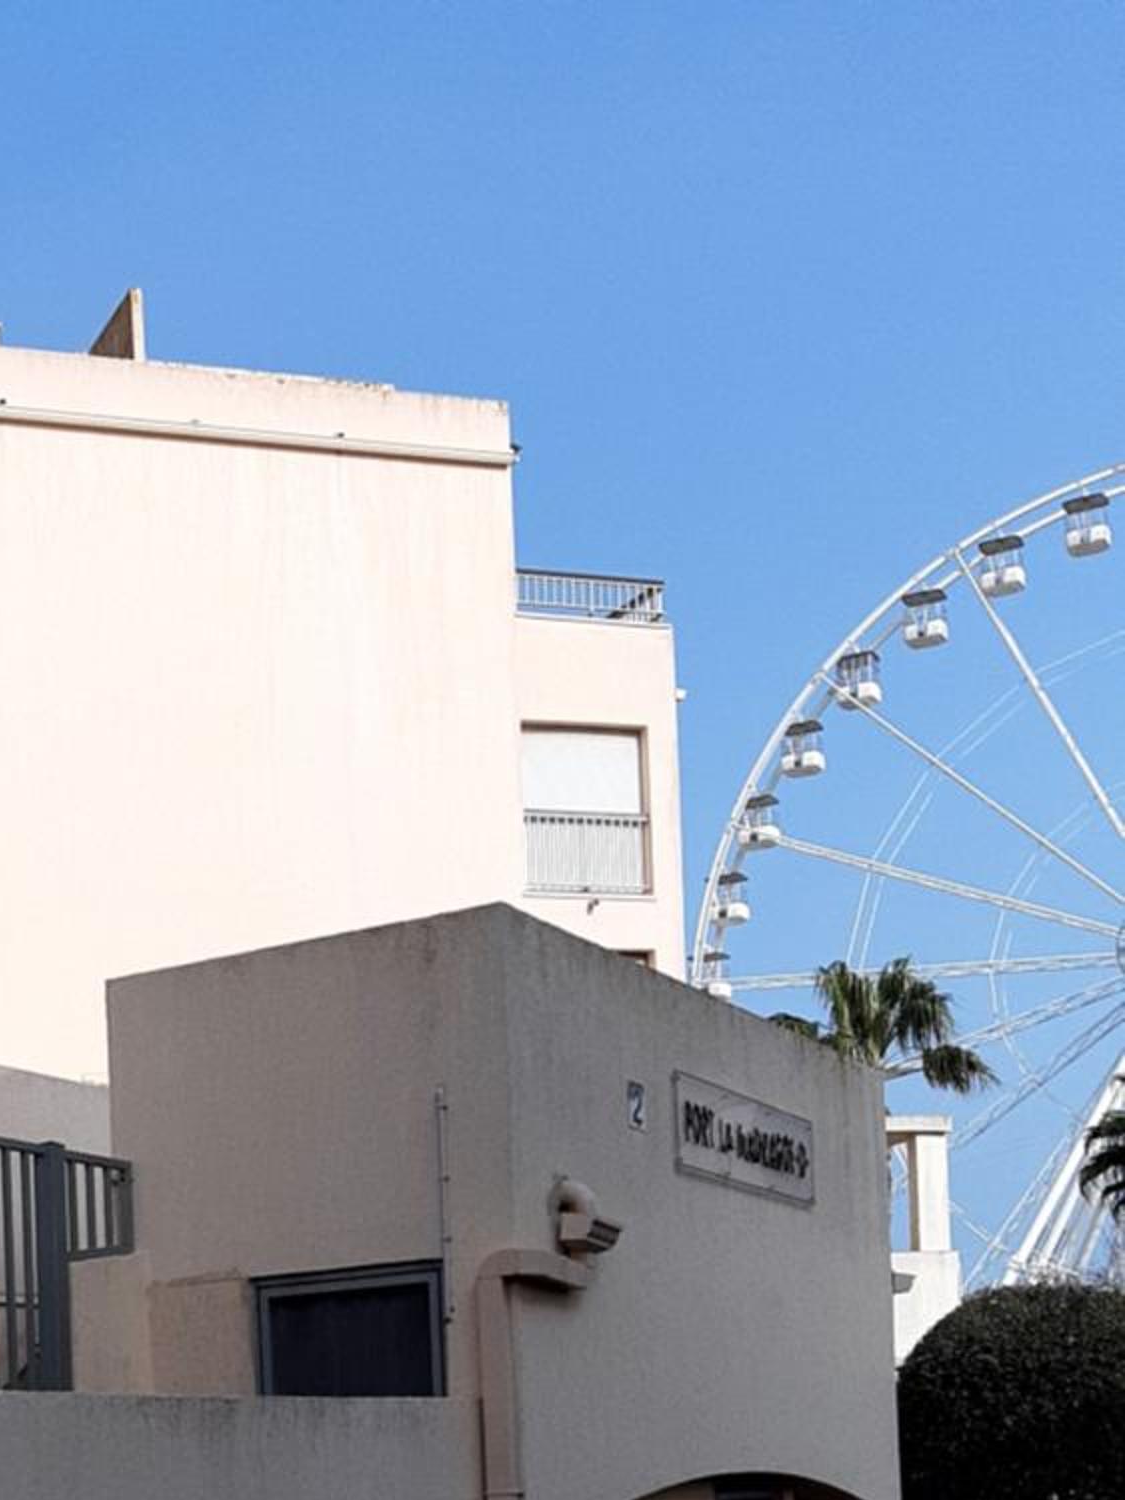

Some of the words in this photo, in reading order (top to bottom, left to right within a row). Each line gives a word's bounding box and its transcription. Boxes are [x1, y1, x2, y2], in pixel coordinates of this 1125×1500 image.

[628, 1086, 643, 1125] 2
[684, 1101, 715, 1149] PORT
[719, 1119, 734, 1154] LA
